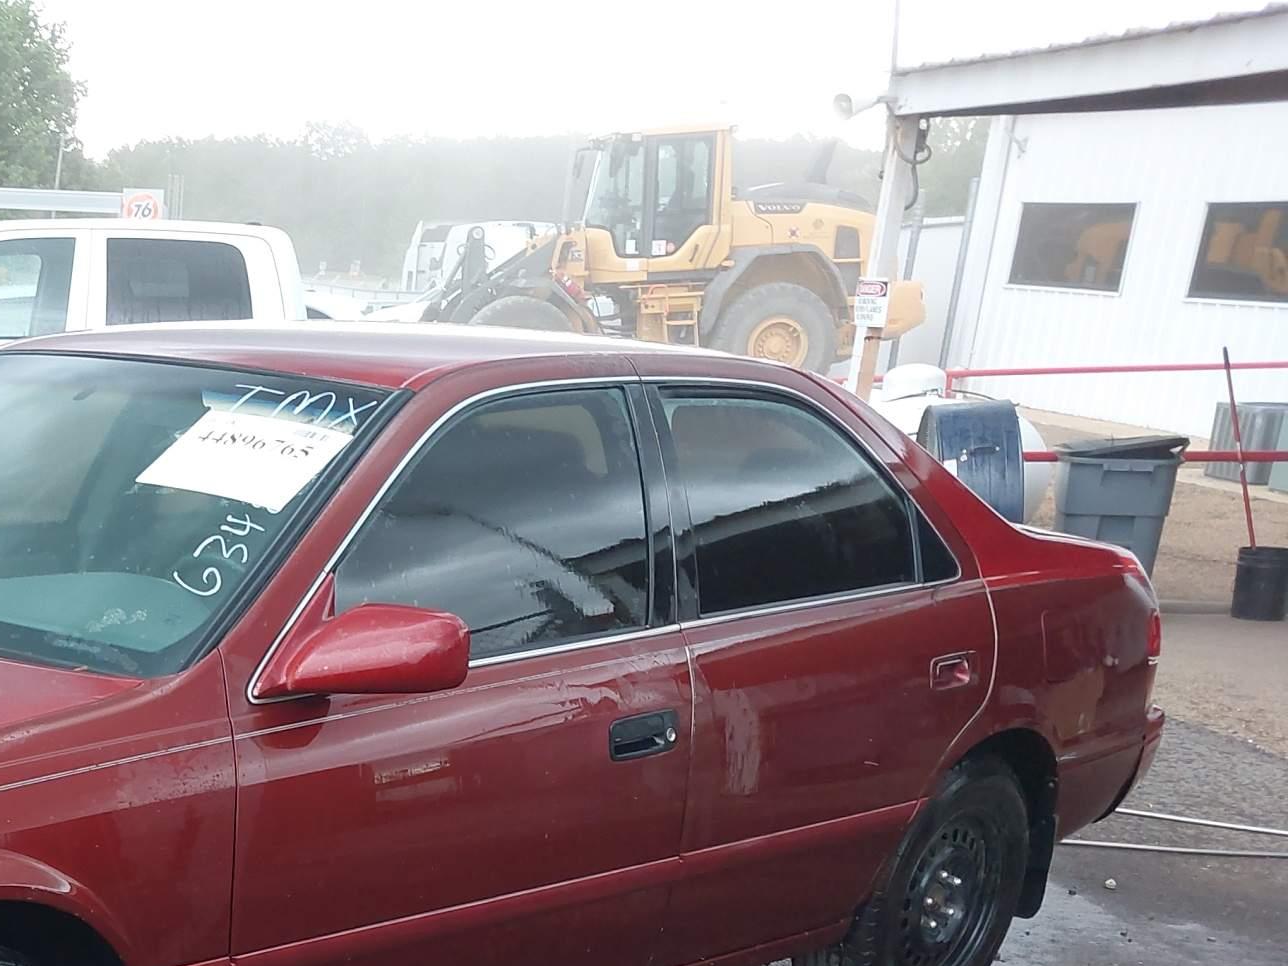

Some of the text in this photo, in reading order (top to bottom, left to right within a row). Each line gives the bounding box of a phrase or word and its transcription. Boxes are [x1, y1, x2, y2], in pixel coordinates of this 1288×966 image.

[134, 203, 152, 217] 76
[757, 203, 802, 212] VOLVO
[198, 430, 314, 459] 44896765
[173, 513, 265, 597] 634
